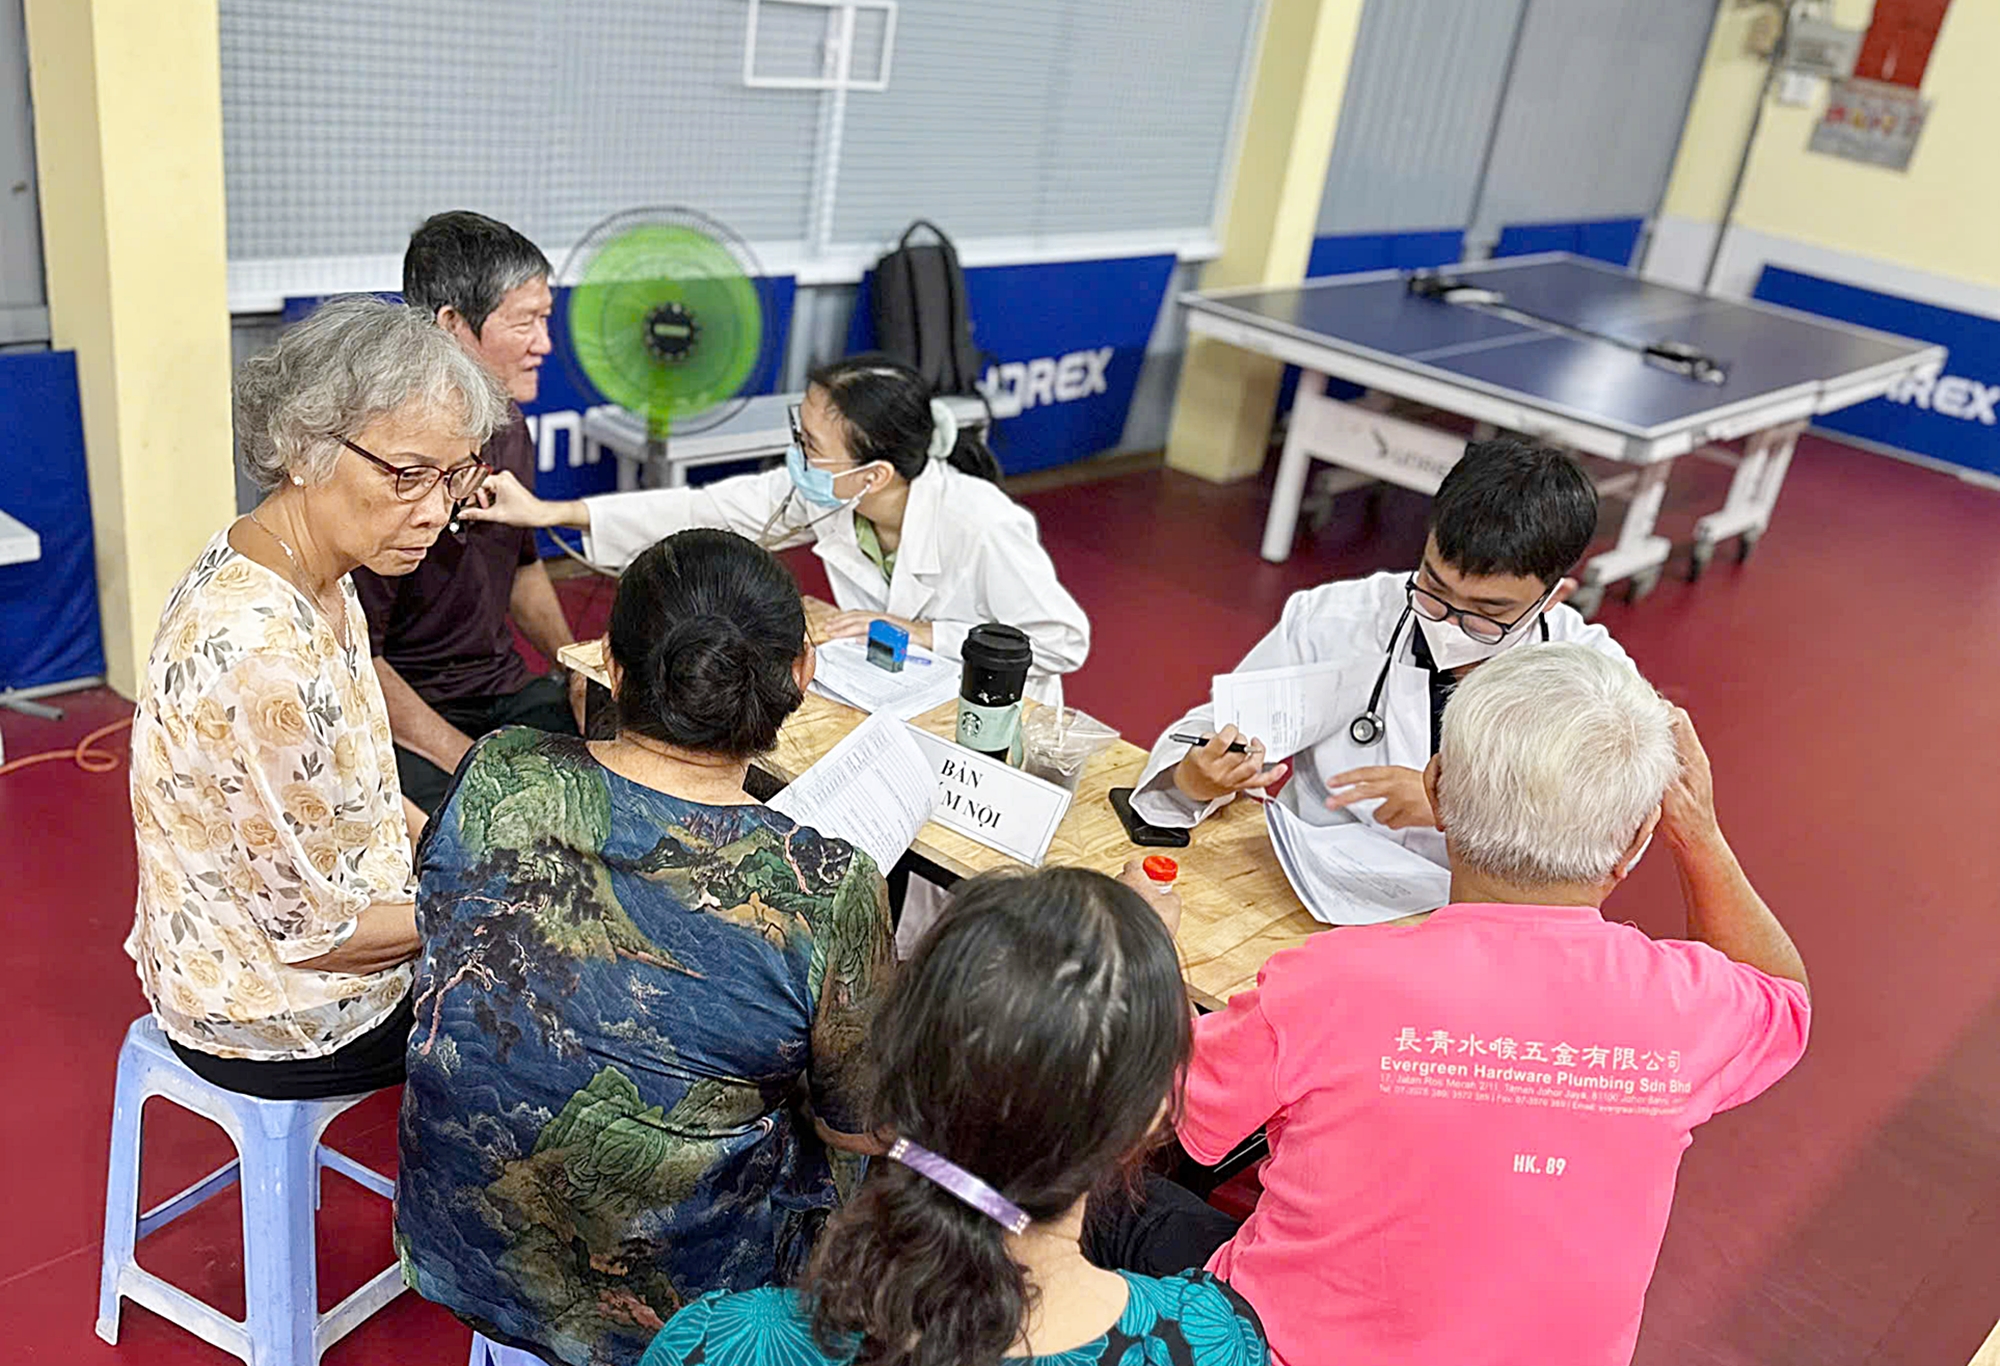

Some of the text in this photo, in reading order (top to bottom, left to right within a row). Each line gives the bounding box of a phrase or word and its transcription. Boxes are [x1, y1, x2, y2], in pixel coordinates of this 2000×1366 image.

[963, 799, 1001, 828] NỘI
[1380, 1056, 1691, 1094] Evergreen Hardware Plumbing Sdn Bhd
[1513, 1154, 1566, 1176] HK. 89
